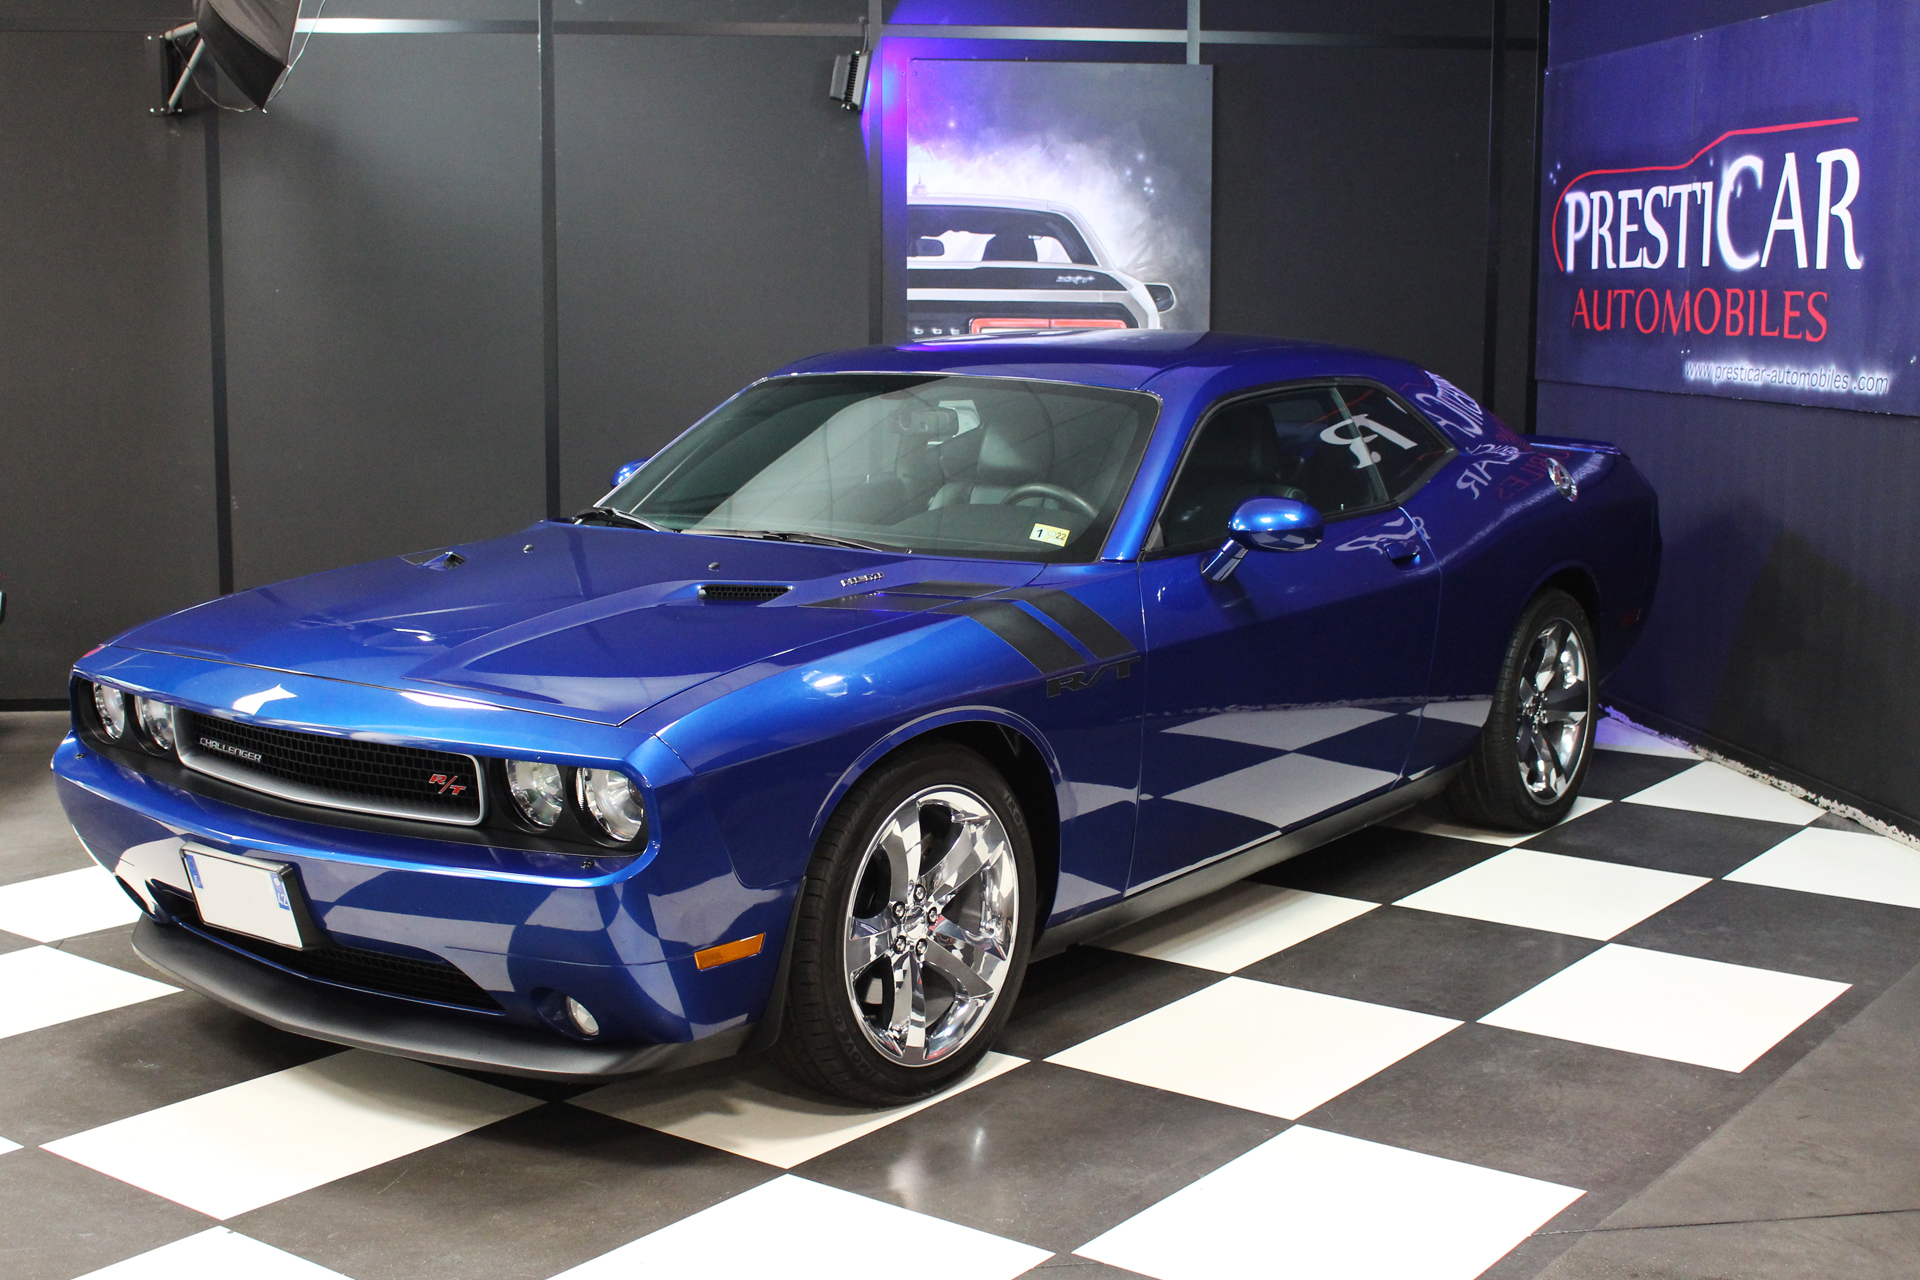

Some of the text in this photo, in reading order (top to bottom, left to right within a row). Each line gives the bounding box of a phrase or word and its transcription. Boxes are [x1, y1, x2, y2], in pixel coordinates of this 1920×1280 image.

[1565, 148, 1864, 273] PRESTICAR
[1571, 287, 1828, 342] AUTOMOBILES
[1036, 528, 1067, 541] 1 22
[1046, 655, 1141, 698] R/T
[200, 737, 262, 763] CHALLENGER
[428, 773, 467, 796] R/T
